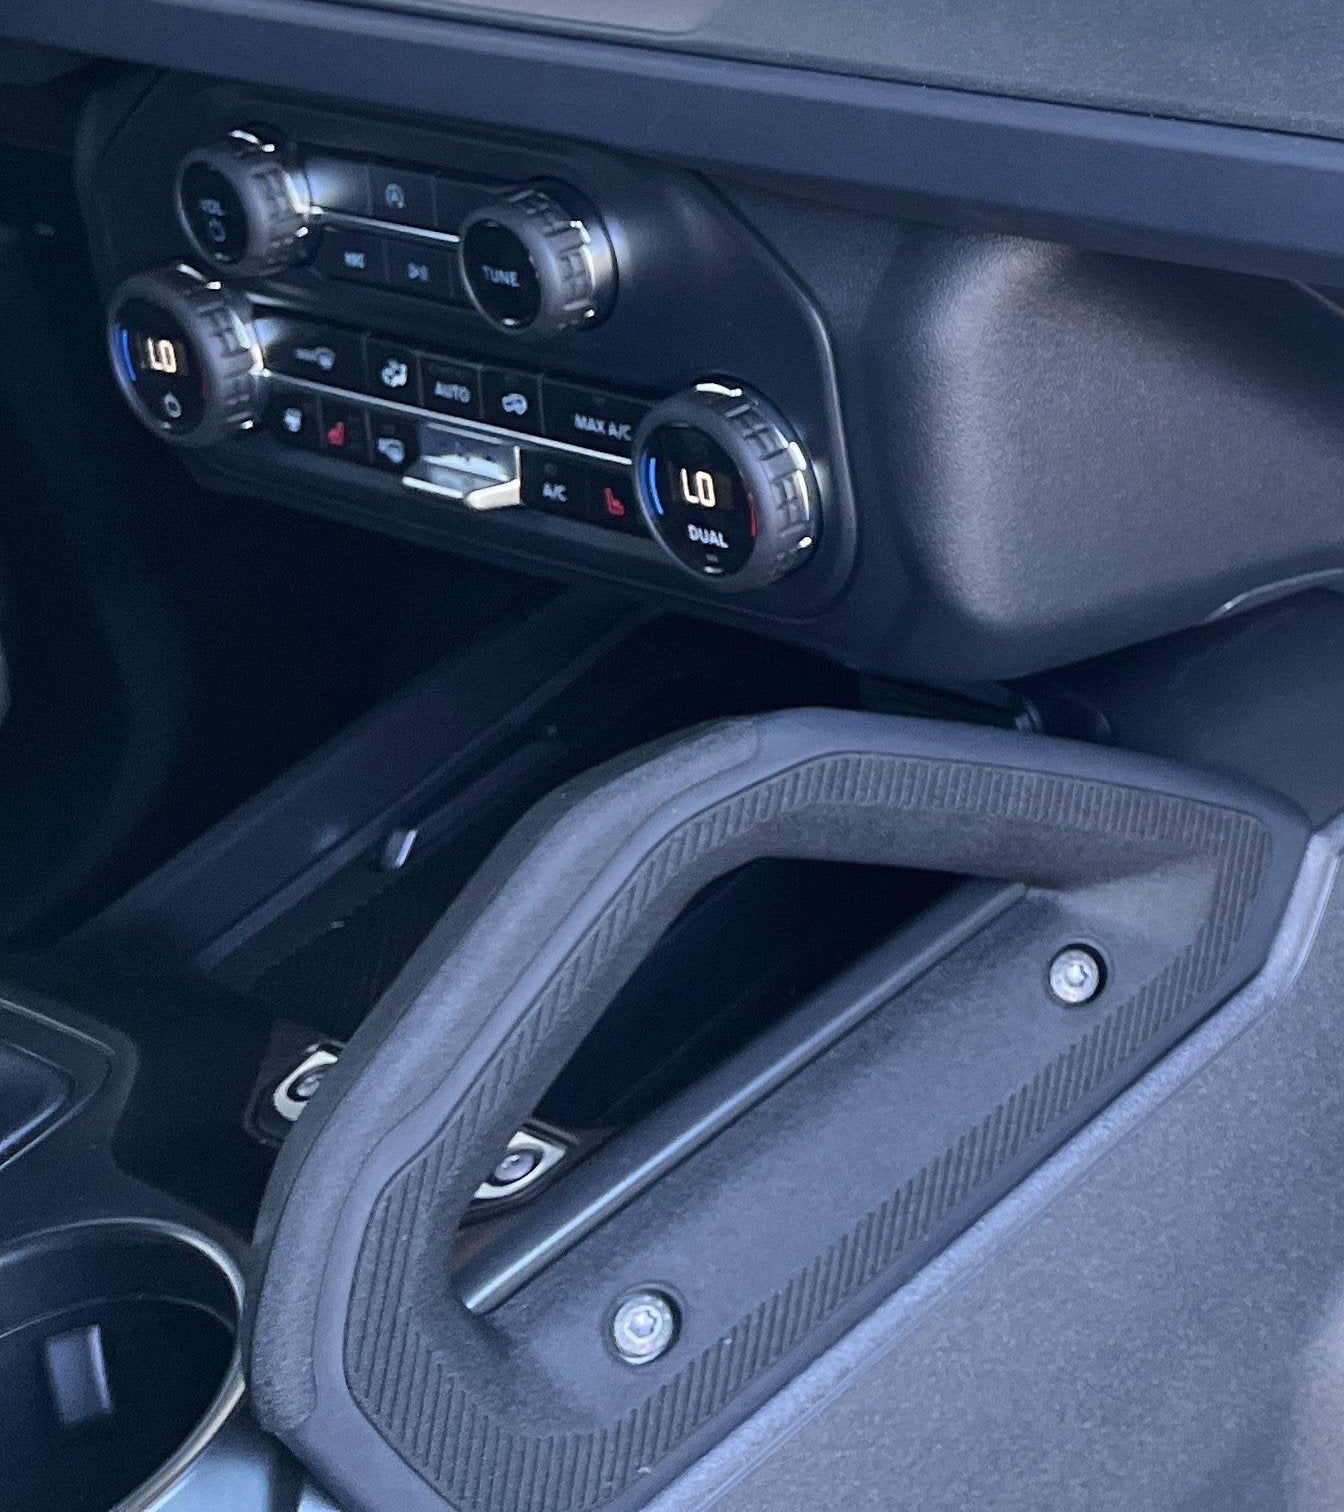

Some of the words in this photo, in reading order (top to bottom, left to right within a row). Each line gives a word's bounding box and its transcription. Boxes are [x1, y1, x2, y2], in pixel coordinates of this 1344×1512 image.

[482, 264, 520, 288] TUNE
[434, 380, 471, 403] AUTO
[574, 413, 606, 434] MAX
[608, 421, 632, 441] A/C
[542, 481, 568, 503] A/C
[687, 524, 730, 549] DUAL
